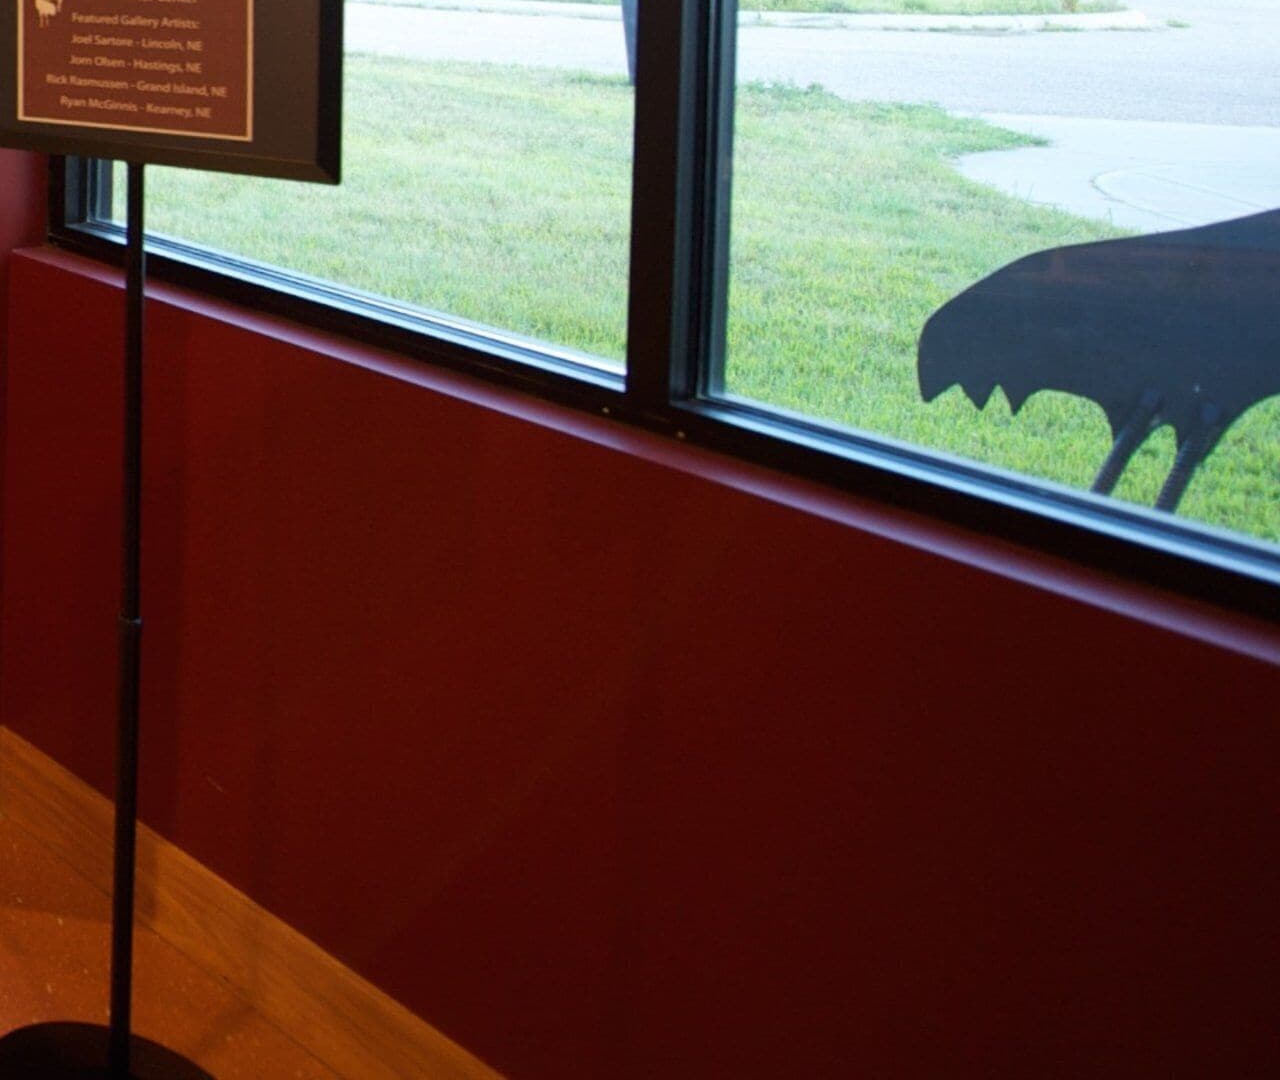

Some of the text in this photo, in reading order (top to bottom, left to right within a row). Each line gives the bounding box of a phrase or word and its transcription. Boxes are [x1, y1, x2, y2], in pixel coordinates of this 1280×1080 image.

[71, 12, 119, 25] Featured
[121, 14, 158, 29] Gallery
[71, 34, 92, 44] Joel
[94, 35, 133, 47] Sartore
[142, 38, 185, 52] Lincoln,
[187, 40, 203, 51] NE
[94, 56, 125, 68] Olsen
[186, 62, 202, 73] NE
[69, 75, 129, 89] Rasmussen
[136, 81, 171, 93] Grand
[173, 83, 209, 96] Island,
[211, 86, 227, 97] NE
[60, 95, 86, 108] Ryan
[88, 98, 138, 112] McGinnis
[146, 104, 193, 118] Kearney,
[195, 107, 211, 118] NE
